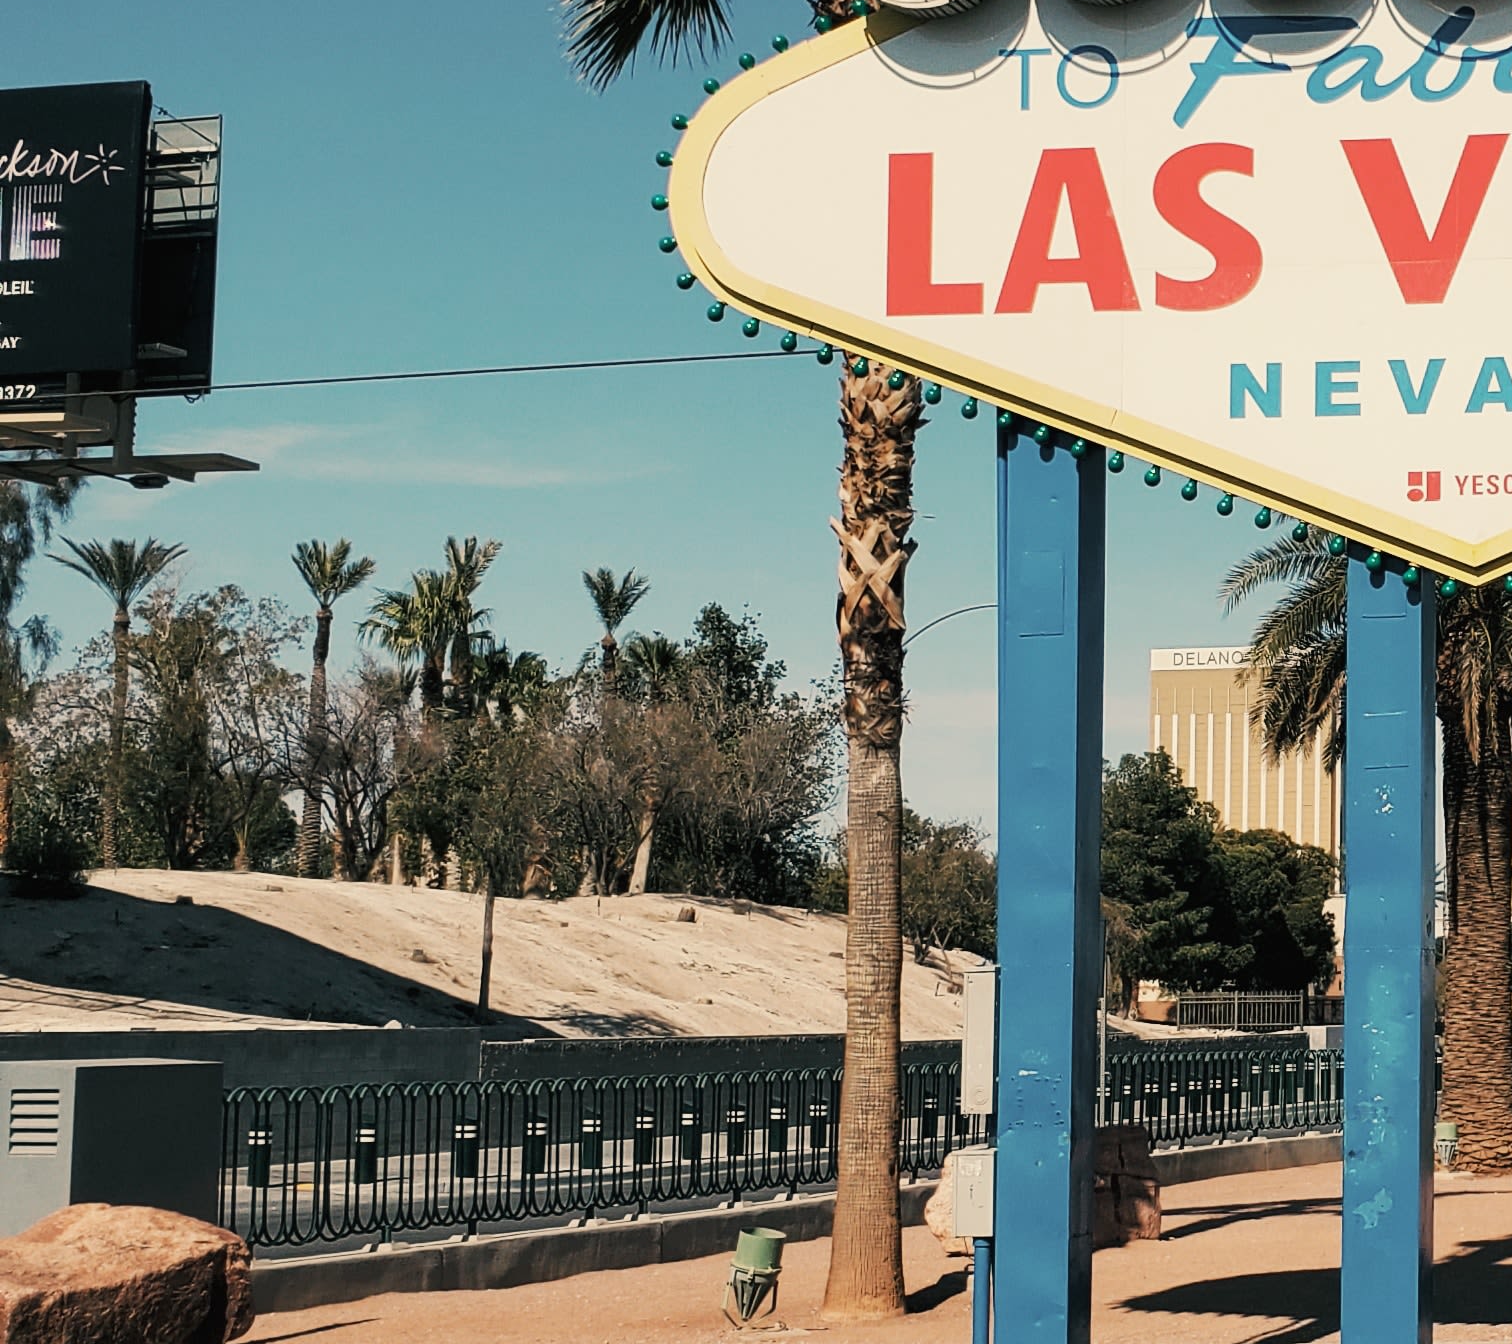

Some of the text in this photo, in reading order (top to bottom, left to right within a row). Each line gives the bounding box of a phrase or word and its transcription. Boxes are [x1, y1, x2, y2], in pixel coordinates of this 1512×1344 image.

[999, 44, 1119, 111] TO
[886, 142, 1262, 316] LAS
[1173, 651, 1244, 666] DELANO
